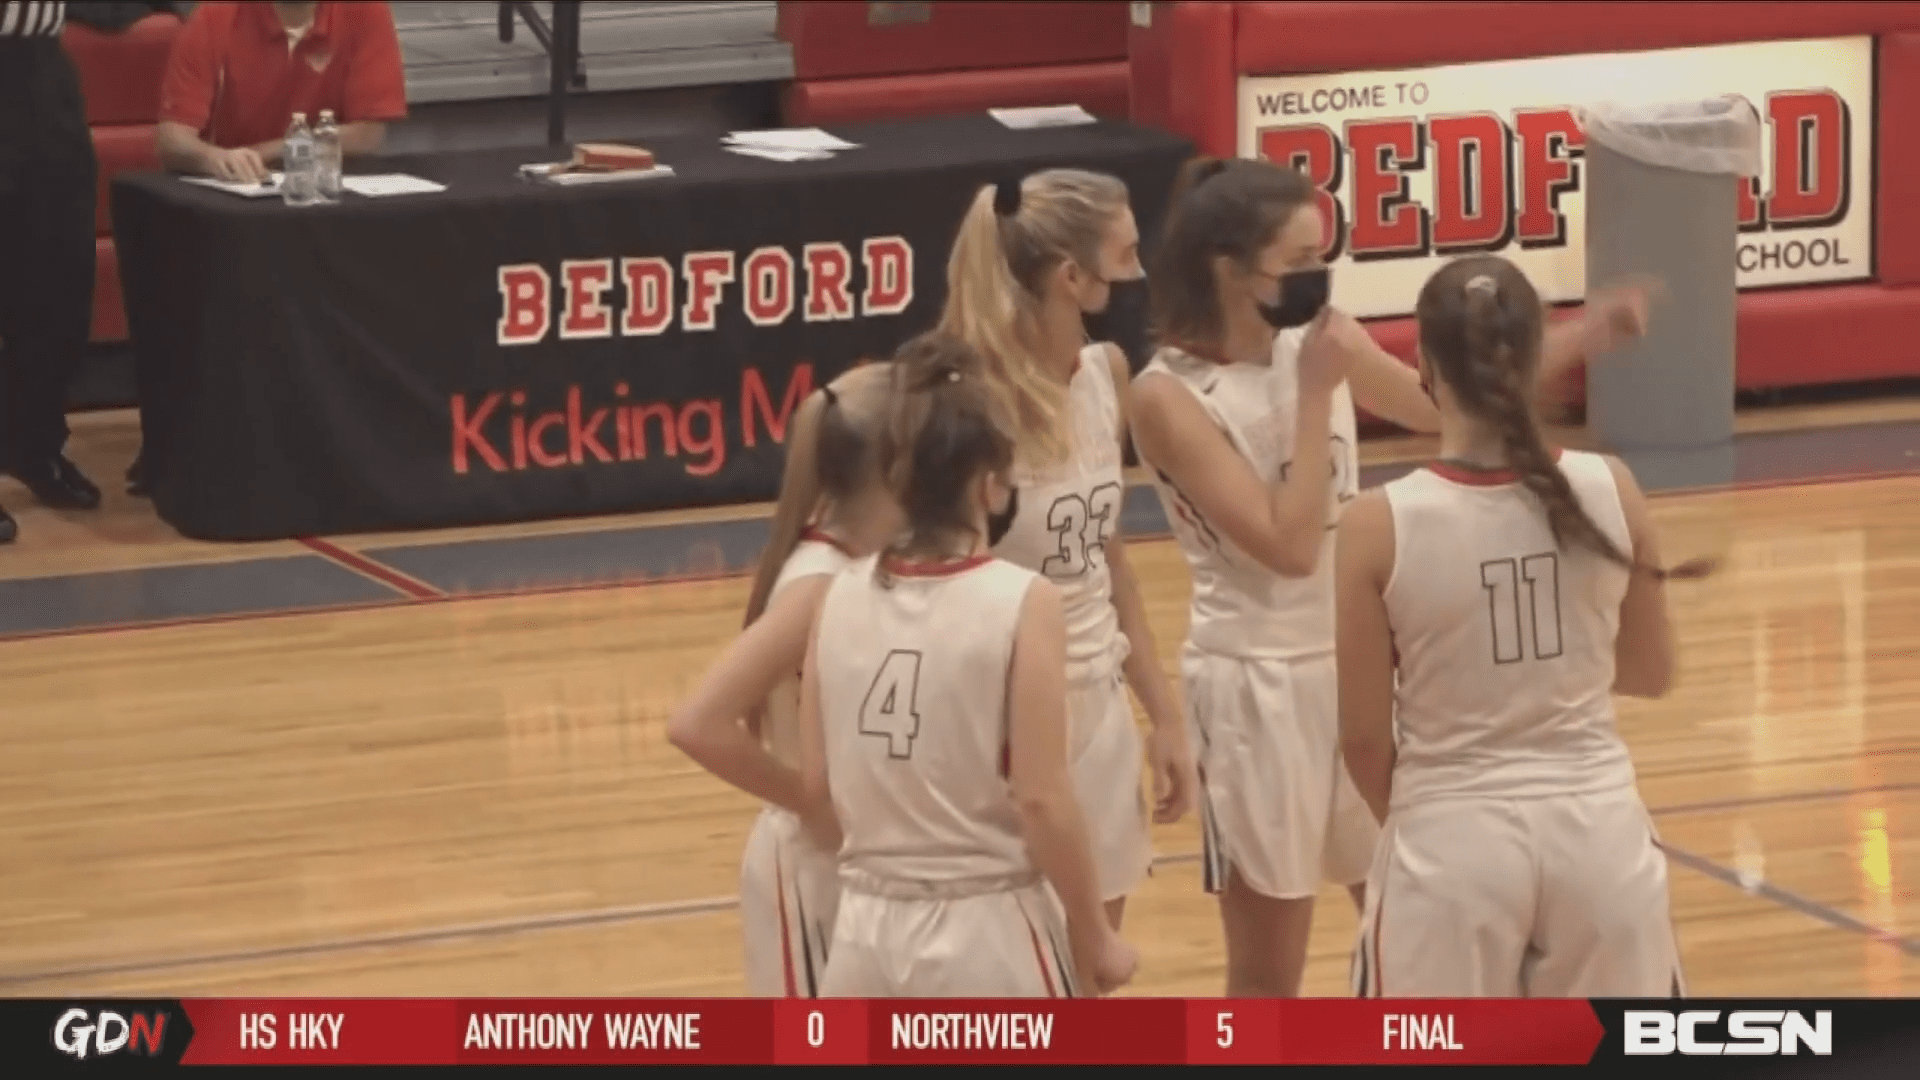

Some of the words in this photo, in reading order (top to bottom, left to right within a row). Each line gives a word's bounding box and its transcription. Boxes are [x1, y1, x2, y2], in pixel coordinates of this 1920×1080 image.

[1256, 83, 1386, 116] WELCOME
[1395, 81, 1430, 106] TO
[1256, 86, 1852, 263] BEDFD
[497, 236, 914, 345] BEDFORD
[1735, 238, 1849, 274] CHOOL
[450, 381, 727, 476] Kicking
[1480, 551, 1563, 665] 11
[857, 648, 923, 761] 4
